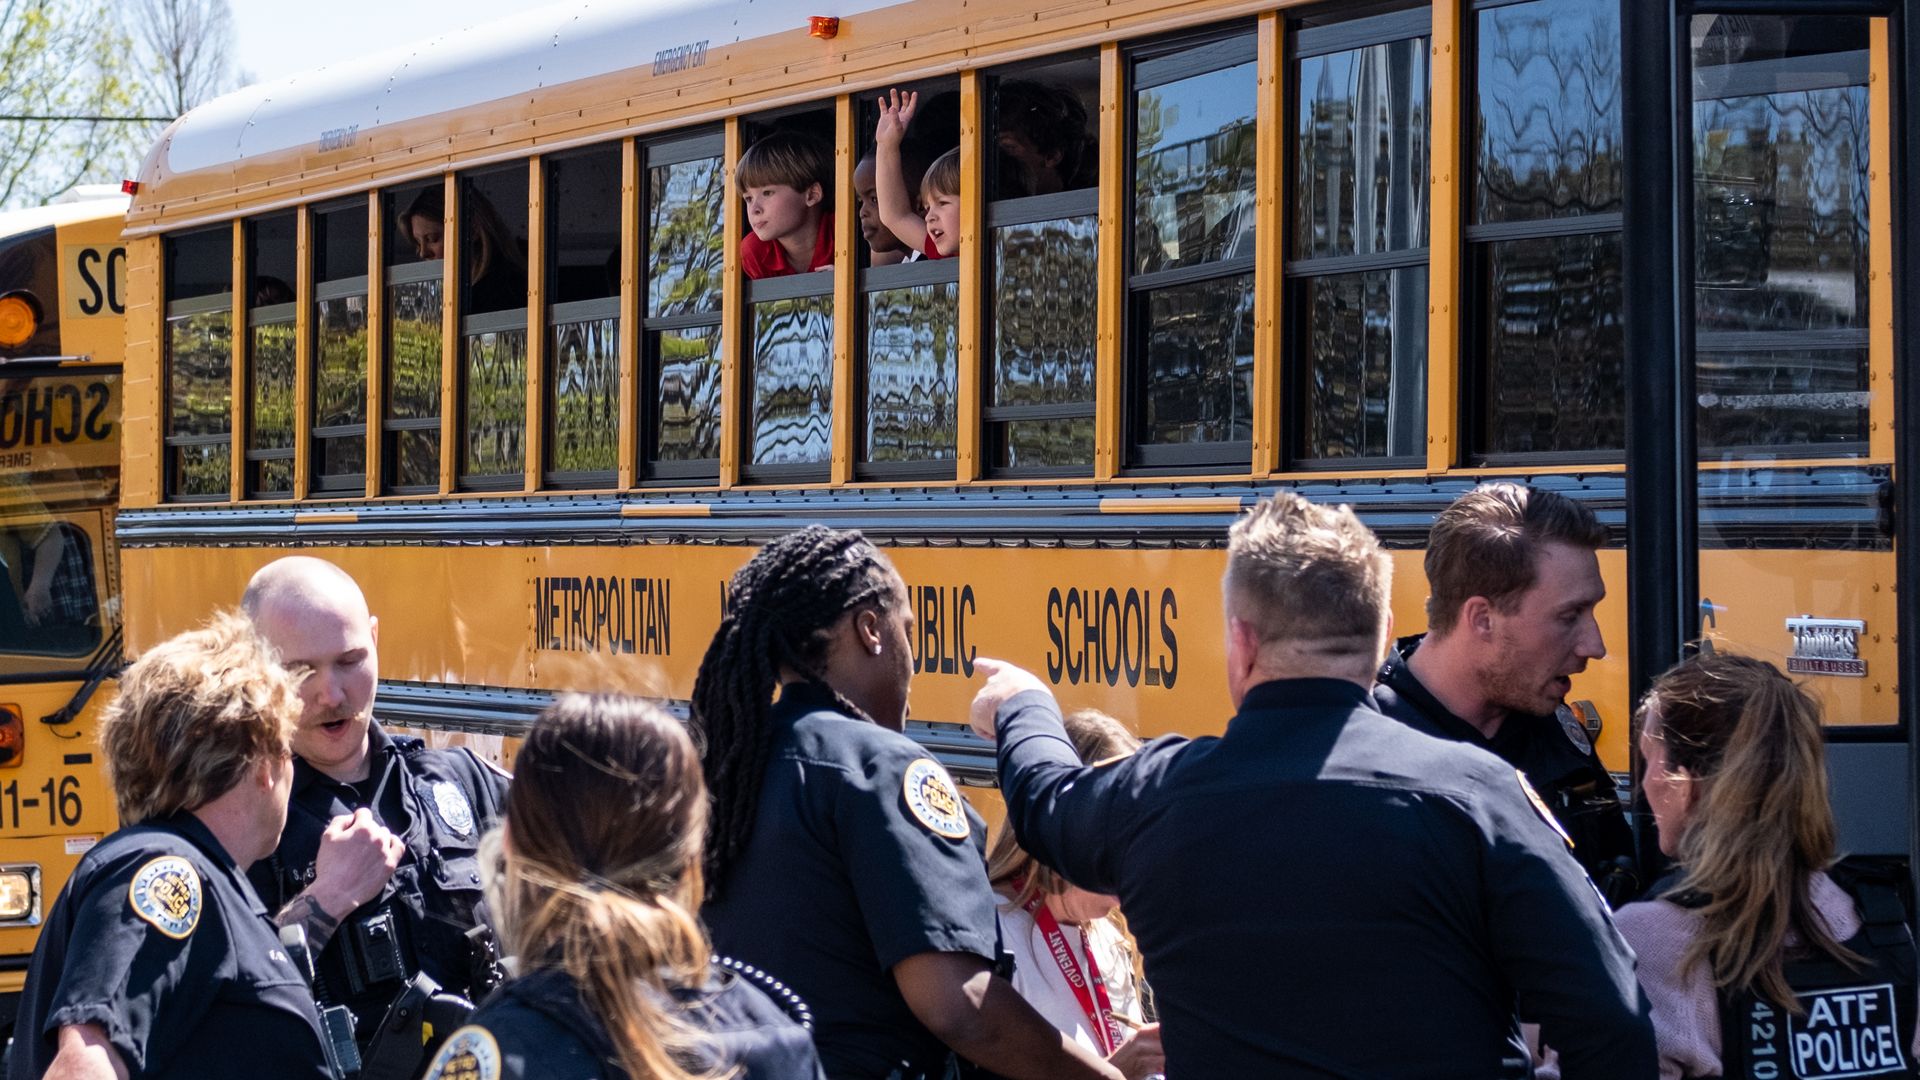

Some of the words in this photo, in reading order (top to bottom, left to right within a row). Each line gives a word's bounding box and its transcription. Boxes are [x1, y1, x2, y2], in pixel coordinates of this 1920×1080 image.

[652, 44, 695, 77] EMERGENCY
[693, 39, 709, 68] EXIT
[536, 576, 670, 656] METROPOLITAN
[908, 584, 976, 679] UBLIC
[1047, 587, 1178, 689] SCHOOLS
[1791, 658, 1820, 671] BUILT
[1823, 660, 1858, 673] BUSES
[0, 775, 82, 827] 1-16
[1049, 930, 1085, 988] COVENANT
[1807, 993, 1878, 1028] ATF
[1751, 1002, 1779, 1079] 4210
[1795, 1025, 1898, 1075] POLICE
